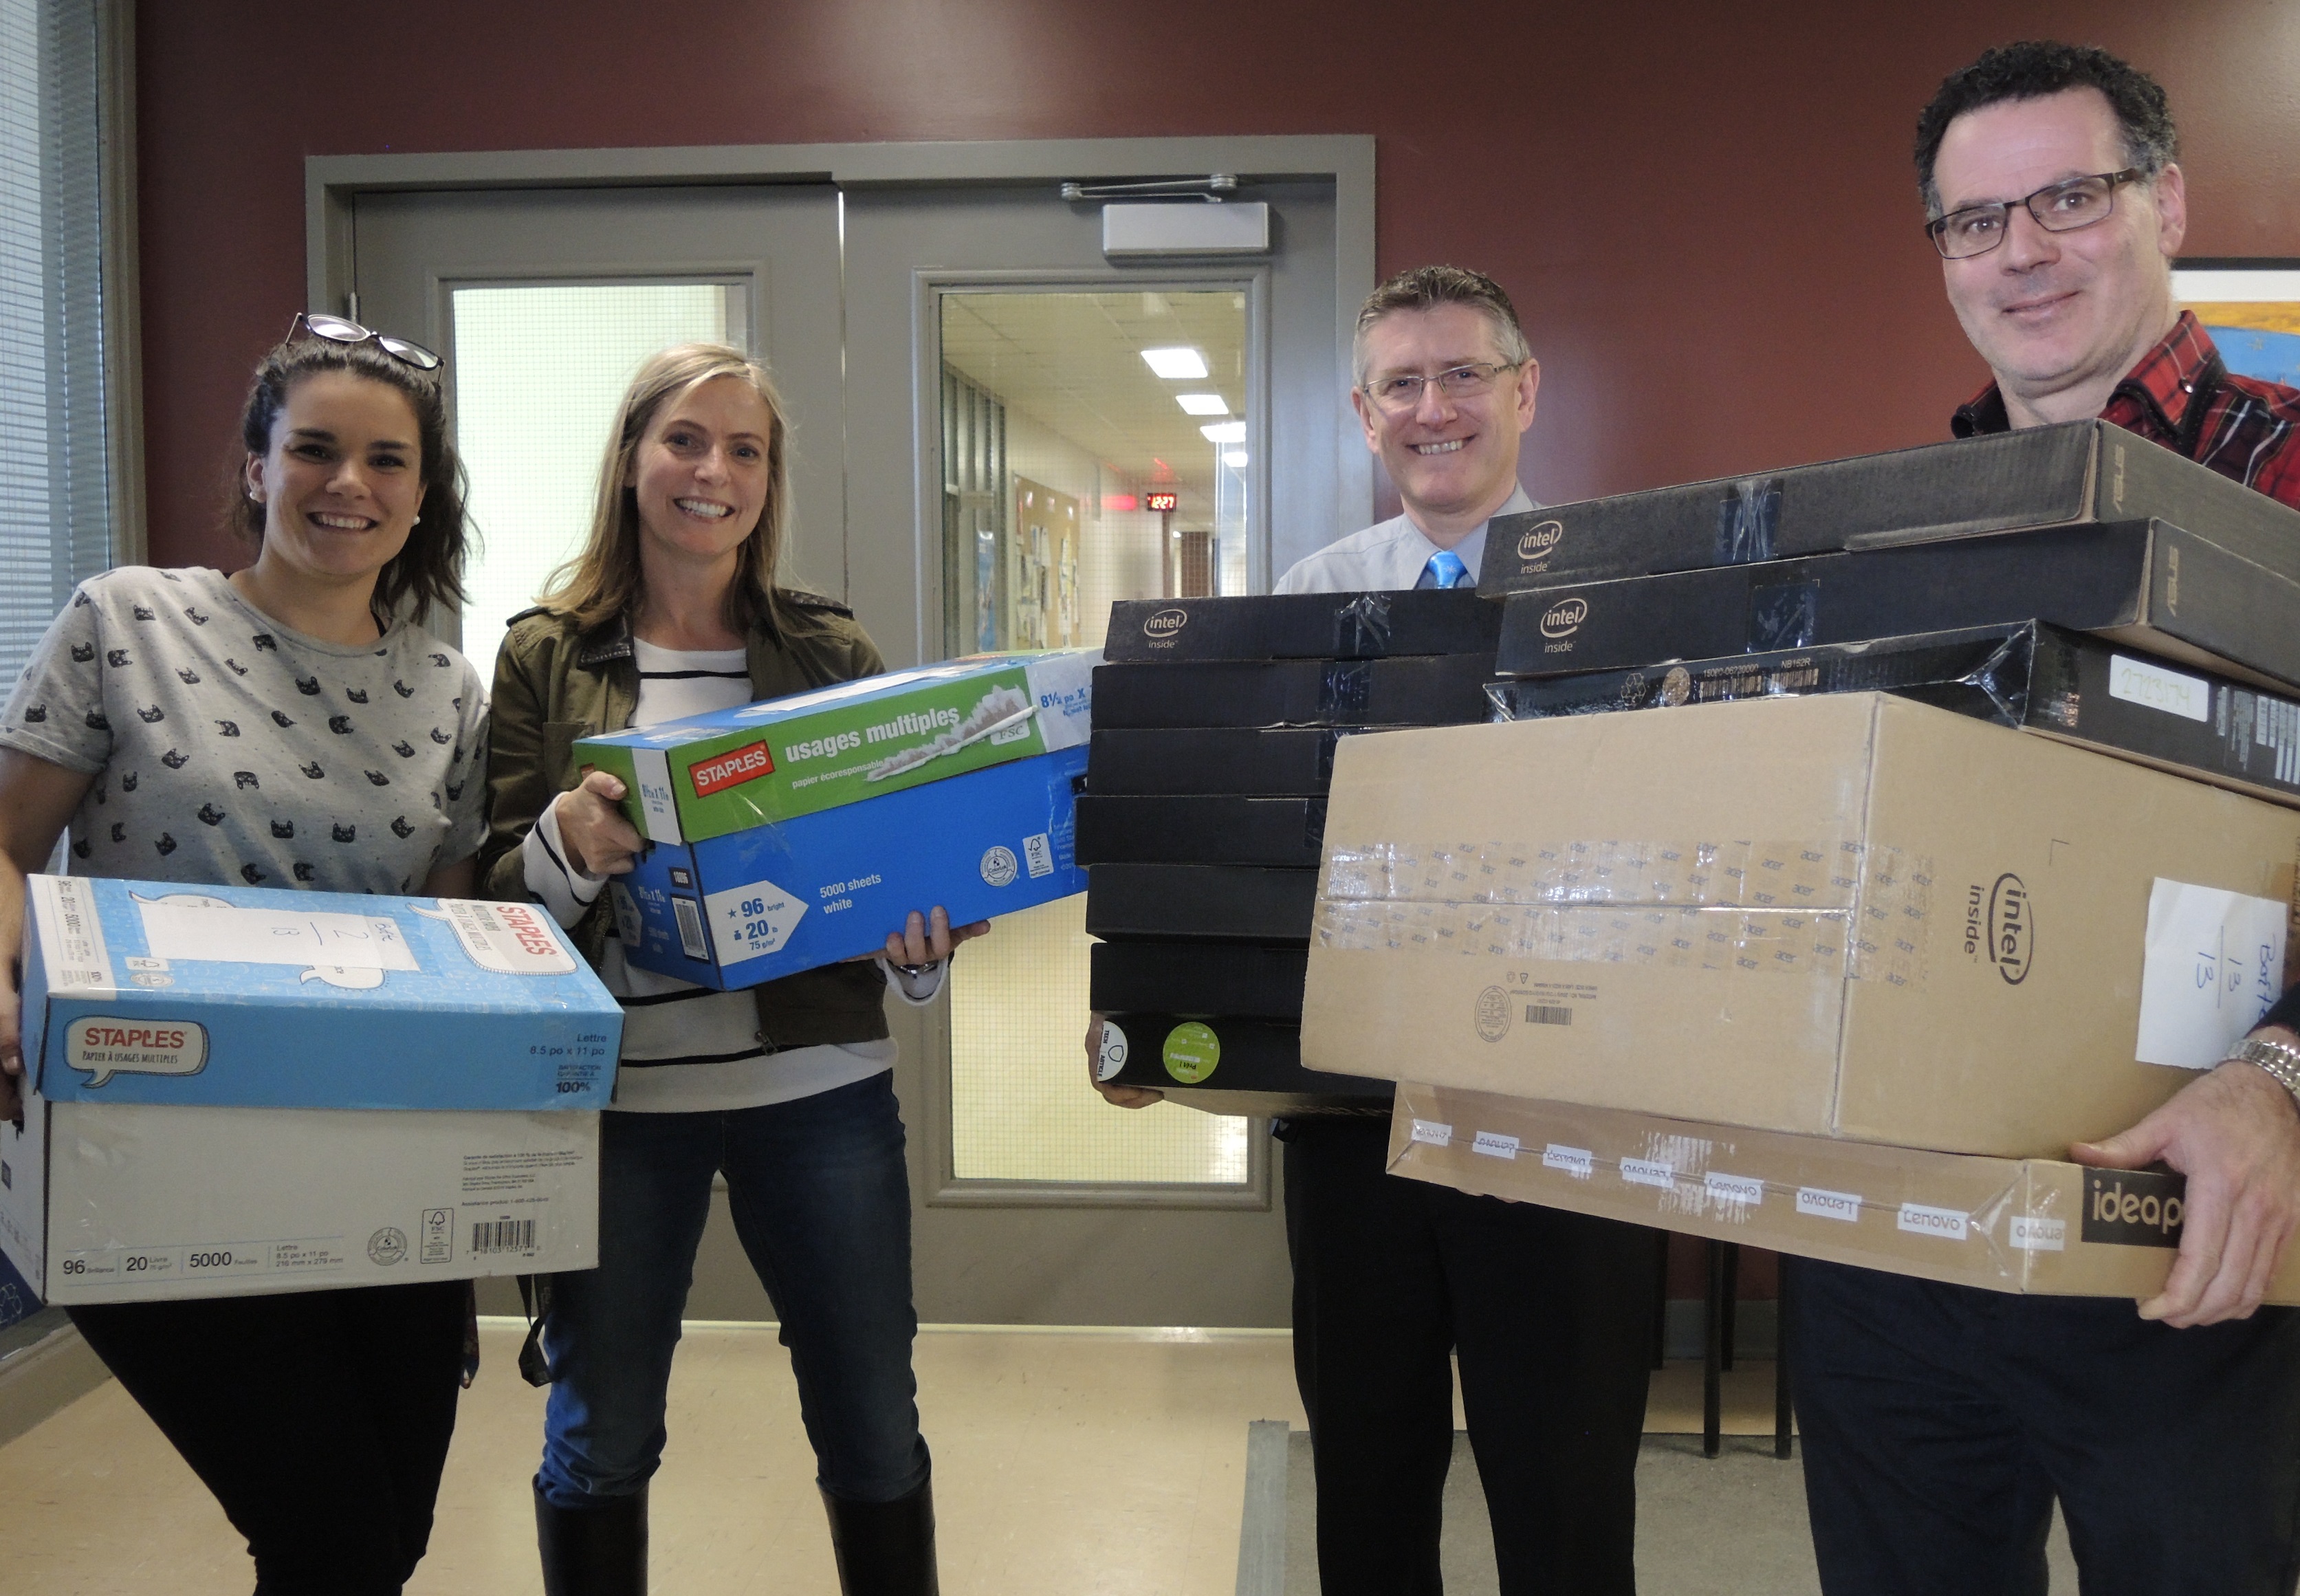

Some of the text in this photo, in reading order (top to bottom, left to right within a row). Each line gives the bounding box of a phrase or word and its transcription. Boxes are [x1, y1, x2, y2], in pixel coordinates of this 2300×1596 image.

[1523, 527, 1555, 549] intel
[1520, 562, 1548, 573] inside
[1150, 615, 1181, 629] intel
[1547, 605, 1579, 626] intel
[1148, 640, 1175, 648] inside
[1544, 640, 1573, 653] inside
[1064, 695, 1074, 704] po
[785, 708, 961, 763] usages multiples
[999, 725, 1025, 740] FSC
[697, 750, 766, 787] STAPLES
[792, 759, 884, 789] papier écoresponsable
[1800, 850, 1824, 863] acer
[1762, 858, 1785, 871] acer
[1724, 866, 1746, 879] acer
[1874, 872, 1898, 886] acer
[1912, 873, 1933, 886] acer
[820, 874, 881, 899] 5000 sheets
[1688, 874, 1710, 886] acer
[1830, 875, 1857, 888] acer
[1791, 884, 1815, 896] acer
[1753, 892, 1776, 904] acer
[741, 898, 765, 918] 96
[823, 898, 853, 915] white
[1865, 906, 1888, 920] acer
[1903, 905, 1925, 920] acer
[1782, 917, 1804, 928] acer
[1964, 884, 1985, 954] inside
[496, 906, 558, 956] STAPLES
[745, 919, 769, 940] 20
[1743, 923, 1766, 936] acer
[2000, 887, 2026, 967] intel
[1671, 937, 1691, 949] acer
[1707, 930, 1728, 943] acer
[749, 940, 760, 950] 75
[1812, 943, 1837, 956] acer
[1856, 939, 1879, 954] acer
[1894, 938, 1916, 954] acer
[1736, 956, 1759, 970] acer
[1775, 950, 1797, 963] acer
[2196, 952, 2215, 990] 13
[1885, 972, 1907, 987] acer
[85, 1027, 184, 1049] STAPLES
[578, 1034, 606, 1042] Lettre
[83, 1051, 178, 1064] PAPIER À USAGES MULTIPLES
[530, 1046, 547, 1055] 8.5
[549, 1047, 563, 1057] po
[578, 1047, 587, 1055] 11
[591, 1048, 605, 1057] po
[556, 1080, 591, 1093] 100%
[1801, 1191, 1854, 1216] Lenovo
[1903, 1208, 1961, 1232] Lenovo
[127, 1256, 148, 1271] 20
[189, 1251, 232, 1268] 5000
[63, 1260, 86, 1274] 96
